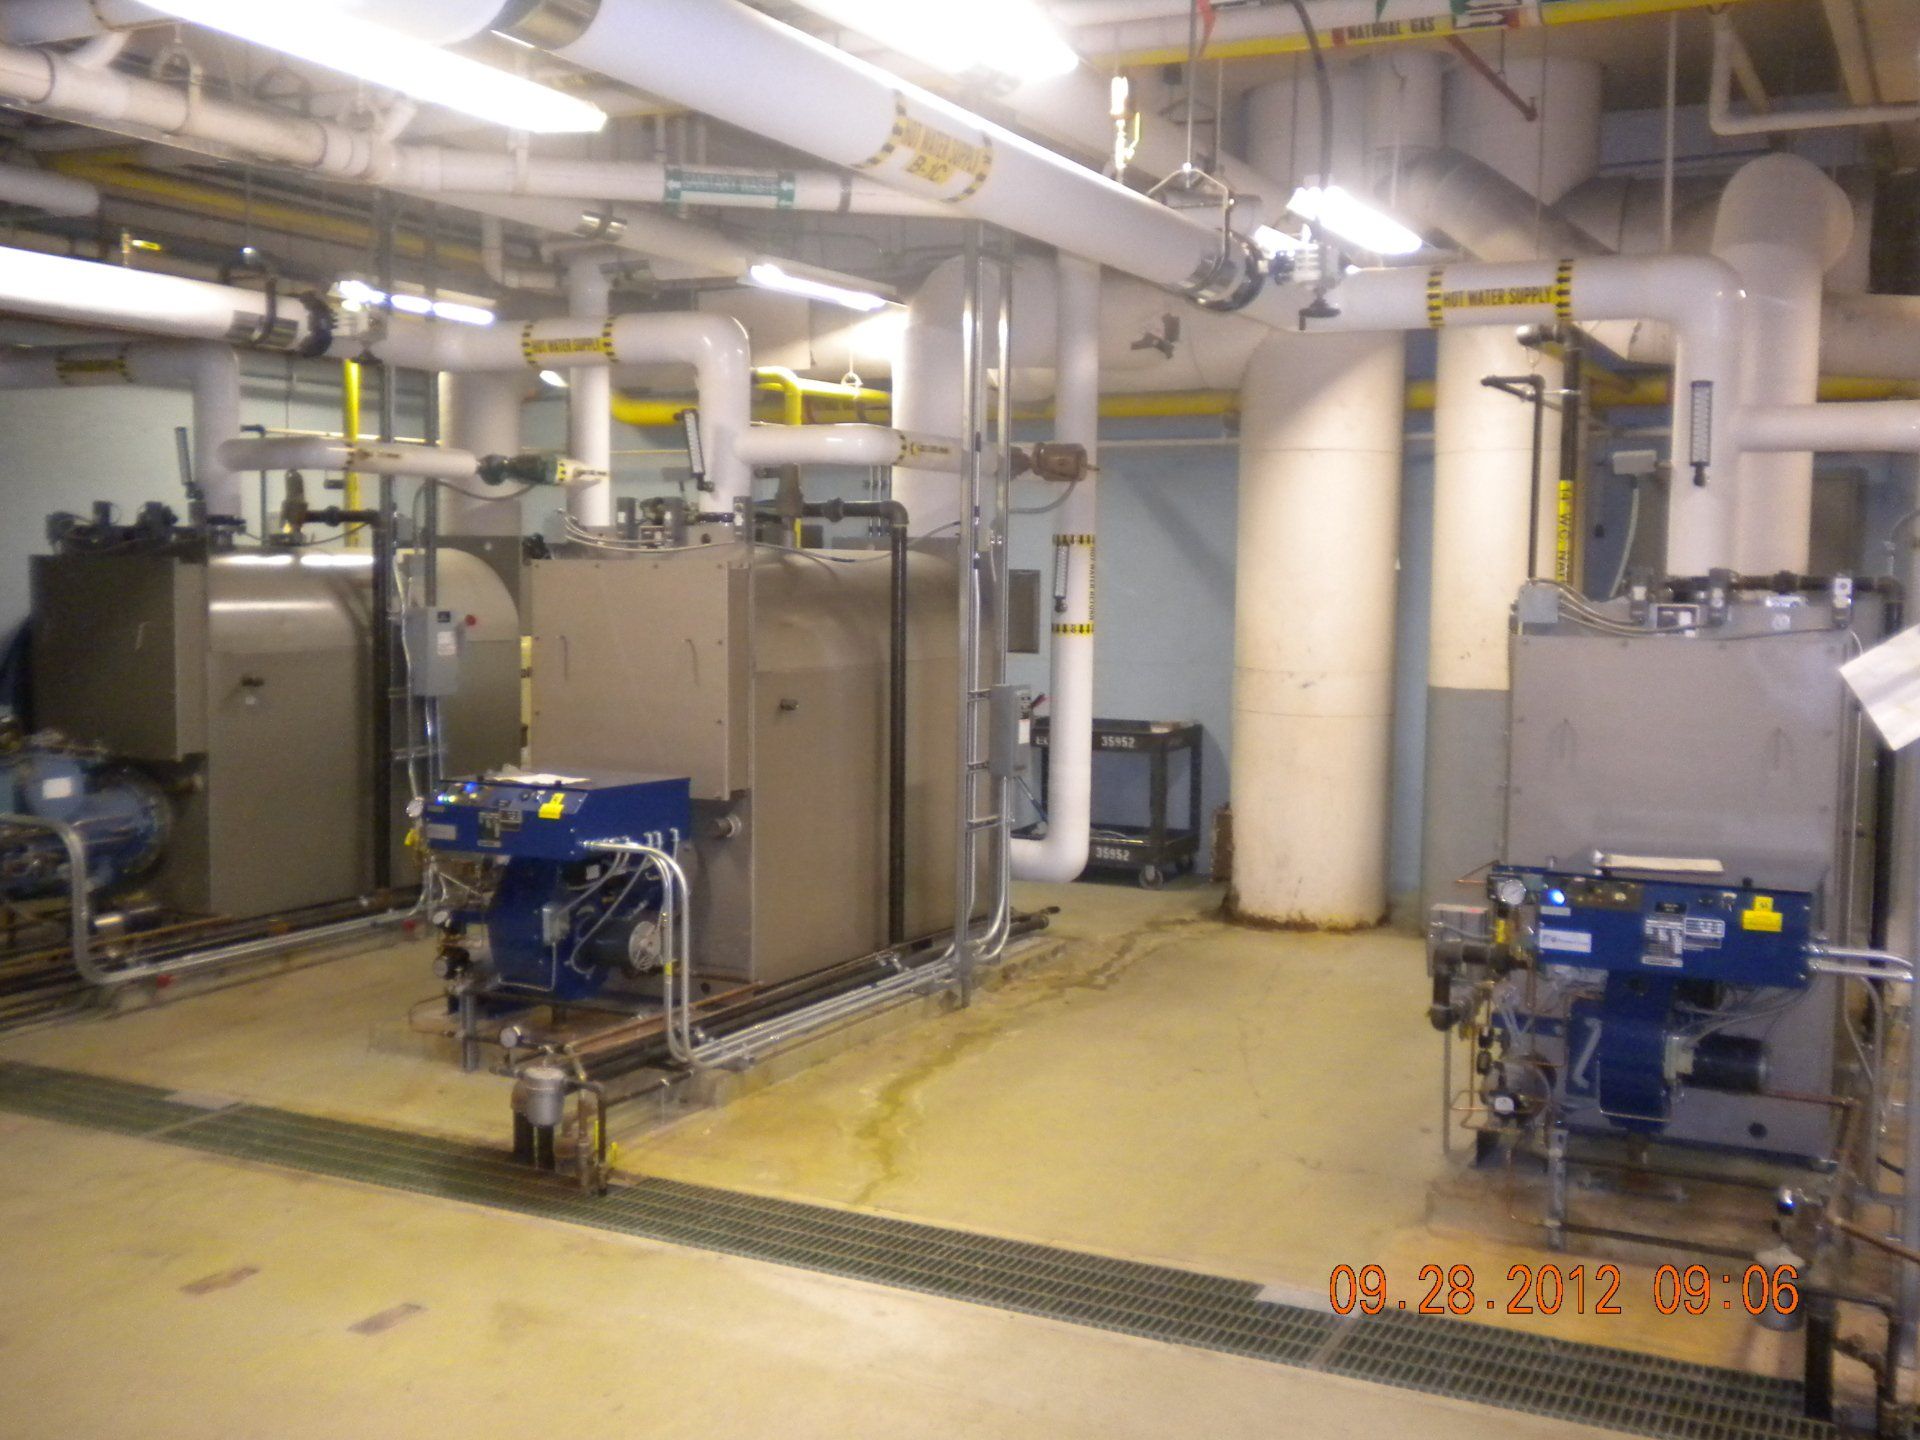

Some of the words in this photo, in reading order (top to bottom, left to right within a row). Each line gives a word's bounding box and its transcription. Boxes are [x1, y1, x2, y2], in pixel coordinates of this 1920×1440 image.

[1348, 22, 1401, 40] NATURAL
[1410, 17, 1435, 33] GAS
[1443, 291, 1465, 307] HOT
[1468, 288, 1505, 306] WATER
[1509, 285, 1554, 304] SUPPLY
